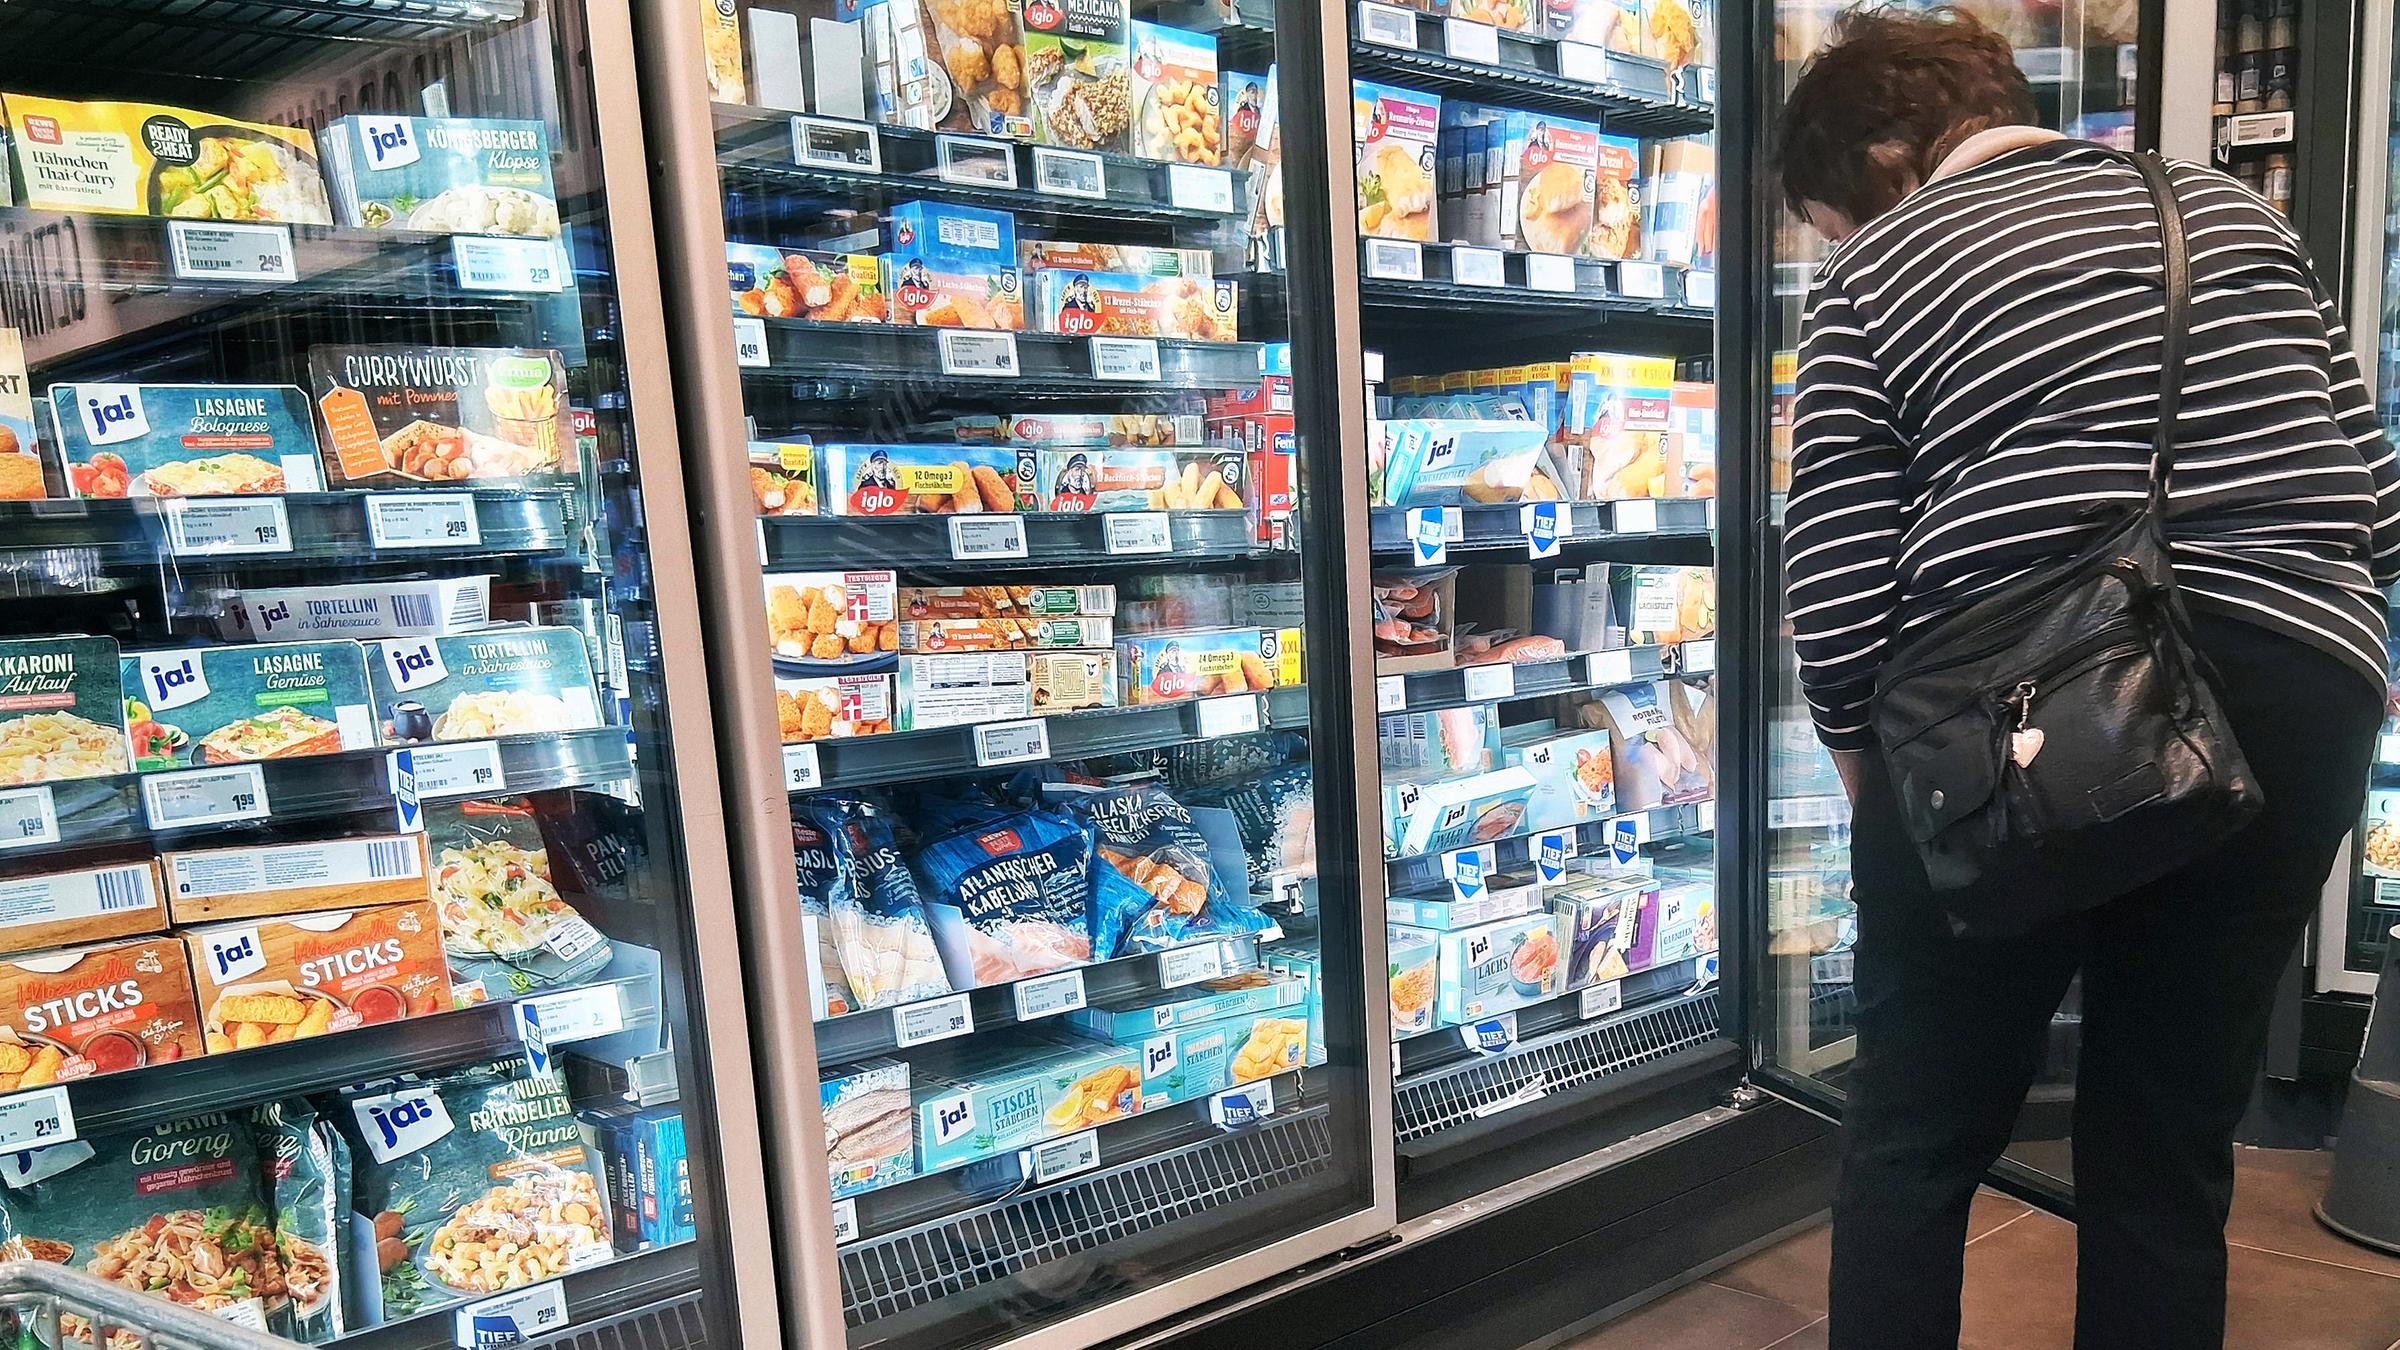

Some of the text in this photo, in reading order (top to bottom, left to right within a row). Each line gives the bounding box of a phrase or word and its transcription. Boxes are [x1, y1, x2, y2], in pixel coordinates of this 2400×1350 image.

[1032, 8, 1054, 25] iglo
[149, 124, 190, 145] READY
[369, 123, 408, 162] ja!
[33, 151, 109, 171] Hähnchen
[488, 151, 541, 174] Klopse
[1529, 150, 1548, 165] iglo
[35, 166, 116, 188] Thai-Curry
[904, 289, 929, 306] iglo
[1065, 313, 1094, 333] iglo
[345, 355, 478, 388] CURRYWURST
[195, 398, 267, 418] LASAGNE
[377, 389, 459, 406] mit Pommes
[88, 394, 136, 436] ja!
[190, 417, 271, 437] Bolognese
[1022, 422, 1043, 437] iglo
[1427, 437, 1454, 466] ja!
[861, 491, 894, 512] iglo
[258, 600, 290, 632] ja!
[305, 598, 379, 616] TORTELLINI
[298, 615, 382, 629] in Sahnesauce
[468, 640, 550, 658] TORTELLINI
[930, 639, 946, 649] iglo
[253, 653, 324, 675] LASAGNE
[392, 646, 434, 683] ja!
[463, 656, 552, 675] in Sahnesauce
[1, 673, 78, 694] Auflauf
[151, 660, 195, 700] ja!
[267, 673, 326, 690] Gemüse
[1160, 674, 1184, 694] iglo
[1091, 794, 1142, 820] ALASKA
[1401, 787, 1419, 812] ja!
[1445, 805, 1465, 827] ja!
[1617, 831, 1636, 843] TIEF
[1543, 846, 1562, 861] TIEF
[959, 852, 1057, 901] ATLANTISCHER
[1458, 864, 1479, 876] TIEF
[1668, 900, 1681, 920] ja!
[213, 936, 254, 975] ja!
[1471, 936, 1489, 963] ja!
[300, 938, 405, 987] STICKS
[1478, 956, 1509, 980] LACHS
[24, 980, 143, 1033] STICKS
[1157, 1007, 1170, 1025] ja!
[1482, 1032, 1505, 1041] TIEF
[1149, 1041, 1172, 1073] ja!
[514, 1078, 565, 1102] NUDEL-
[992, 1087, 1037, 1119] FISCH
[1225, 1107, 1251, 1118] TIEF
[368, 1098, 433, 1149] ja!
[470, 1101, 572, 1133] FRIKADELLEN
[941, 1102, 968, 1137] ja!
[131, 1129, 234, 1166] Goreng
[506, 1124, 580, 1155] Pfanne
[476, 1329, 516, 1343] TIEF
